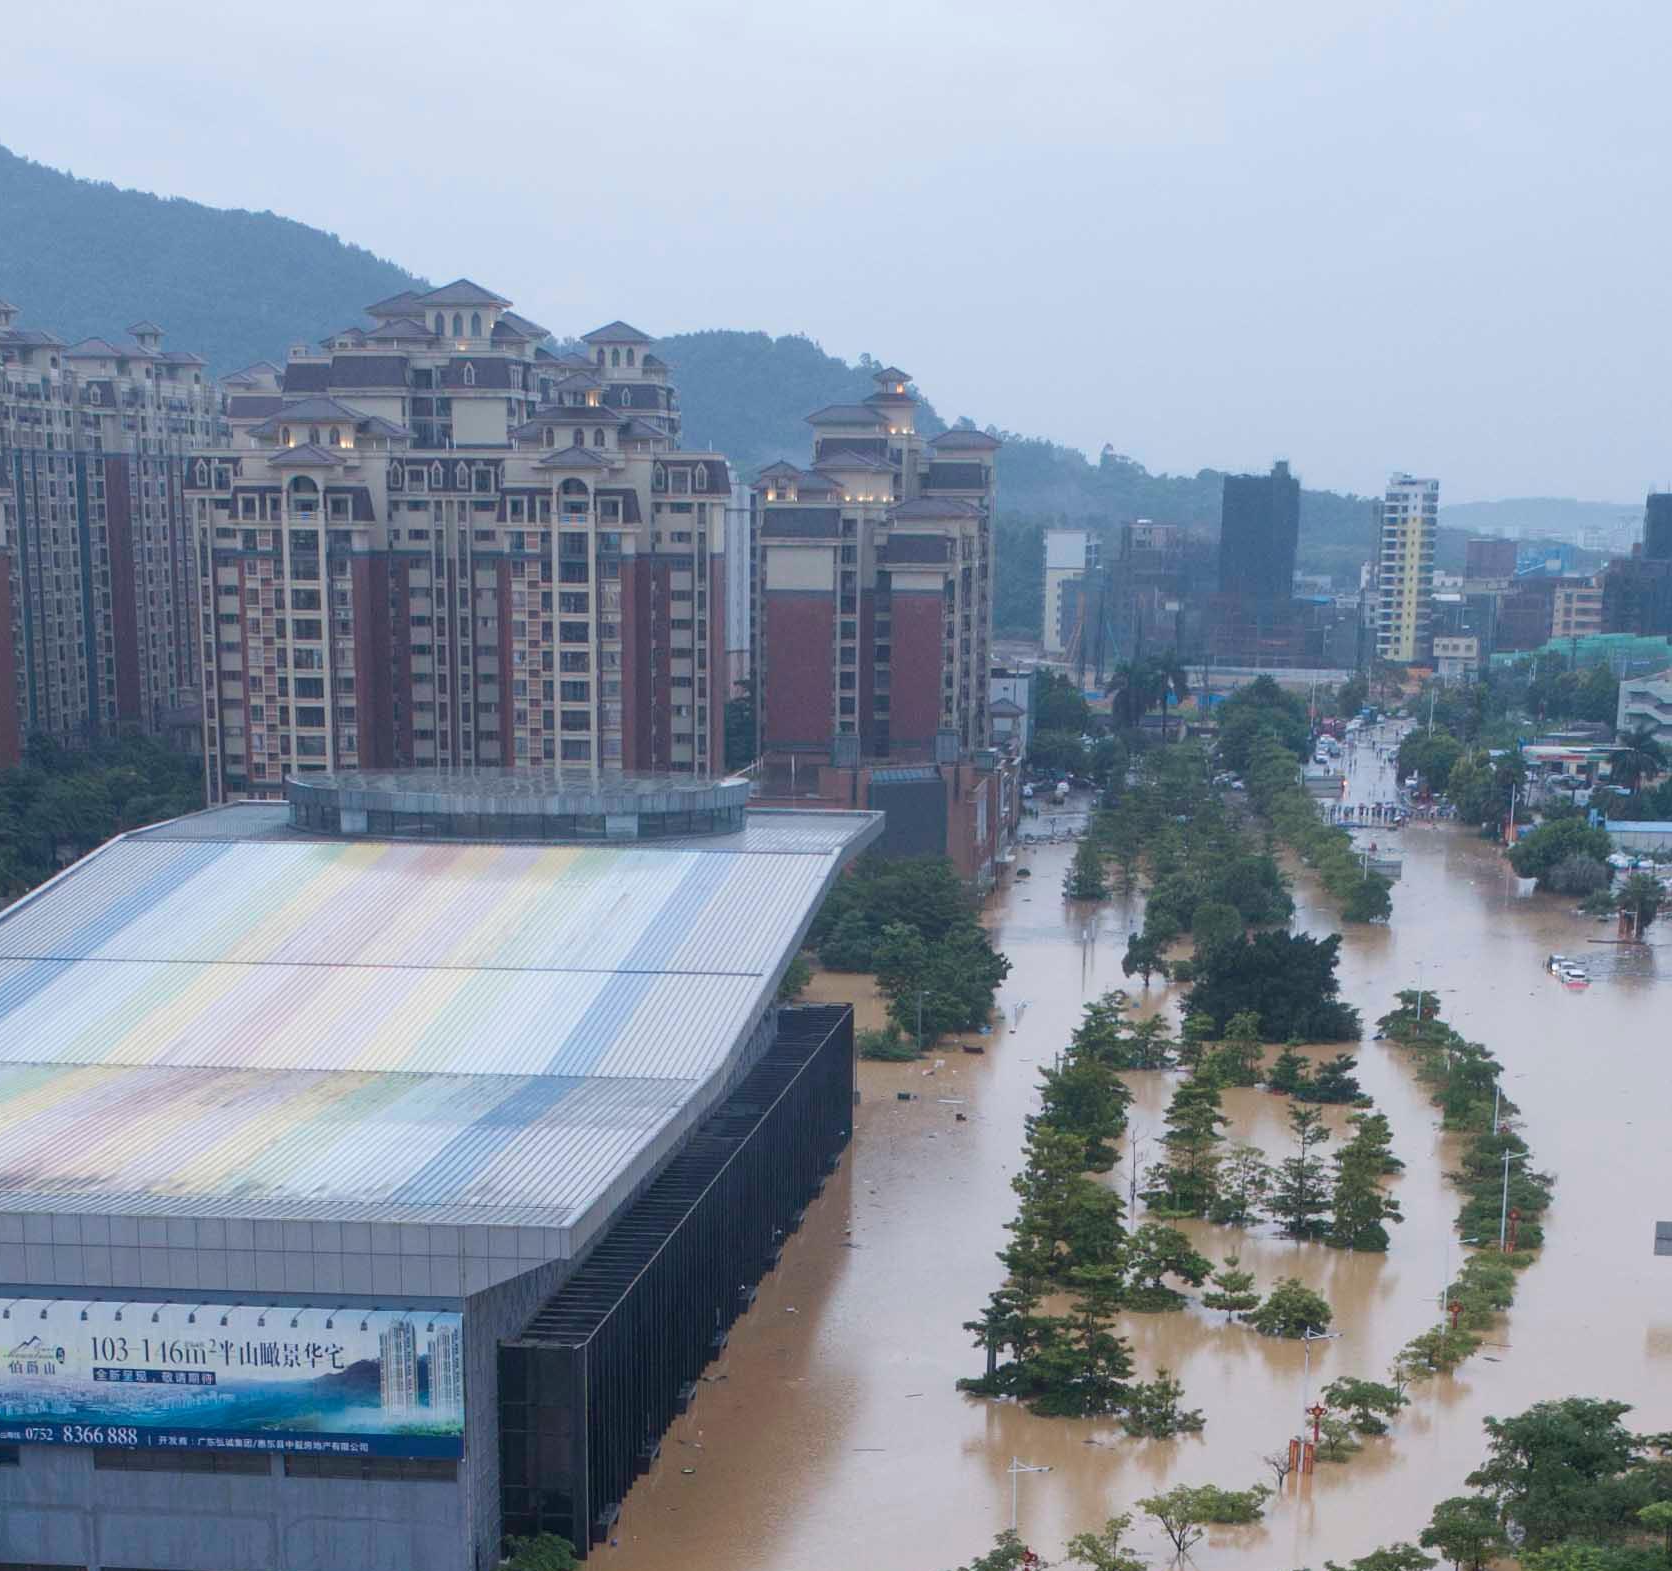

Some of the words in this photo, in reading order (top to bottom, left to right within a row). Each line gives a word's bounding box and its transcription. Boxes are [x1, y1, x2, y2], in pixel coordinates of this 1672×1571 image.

[25, 1427, 54, 1441] 0752
[63, 1425, 104, 1444] 8366
[107, 1426, 138, 1445] 888
